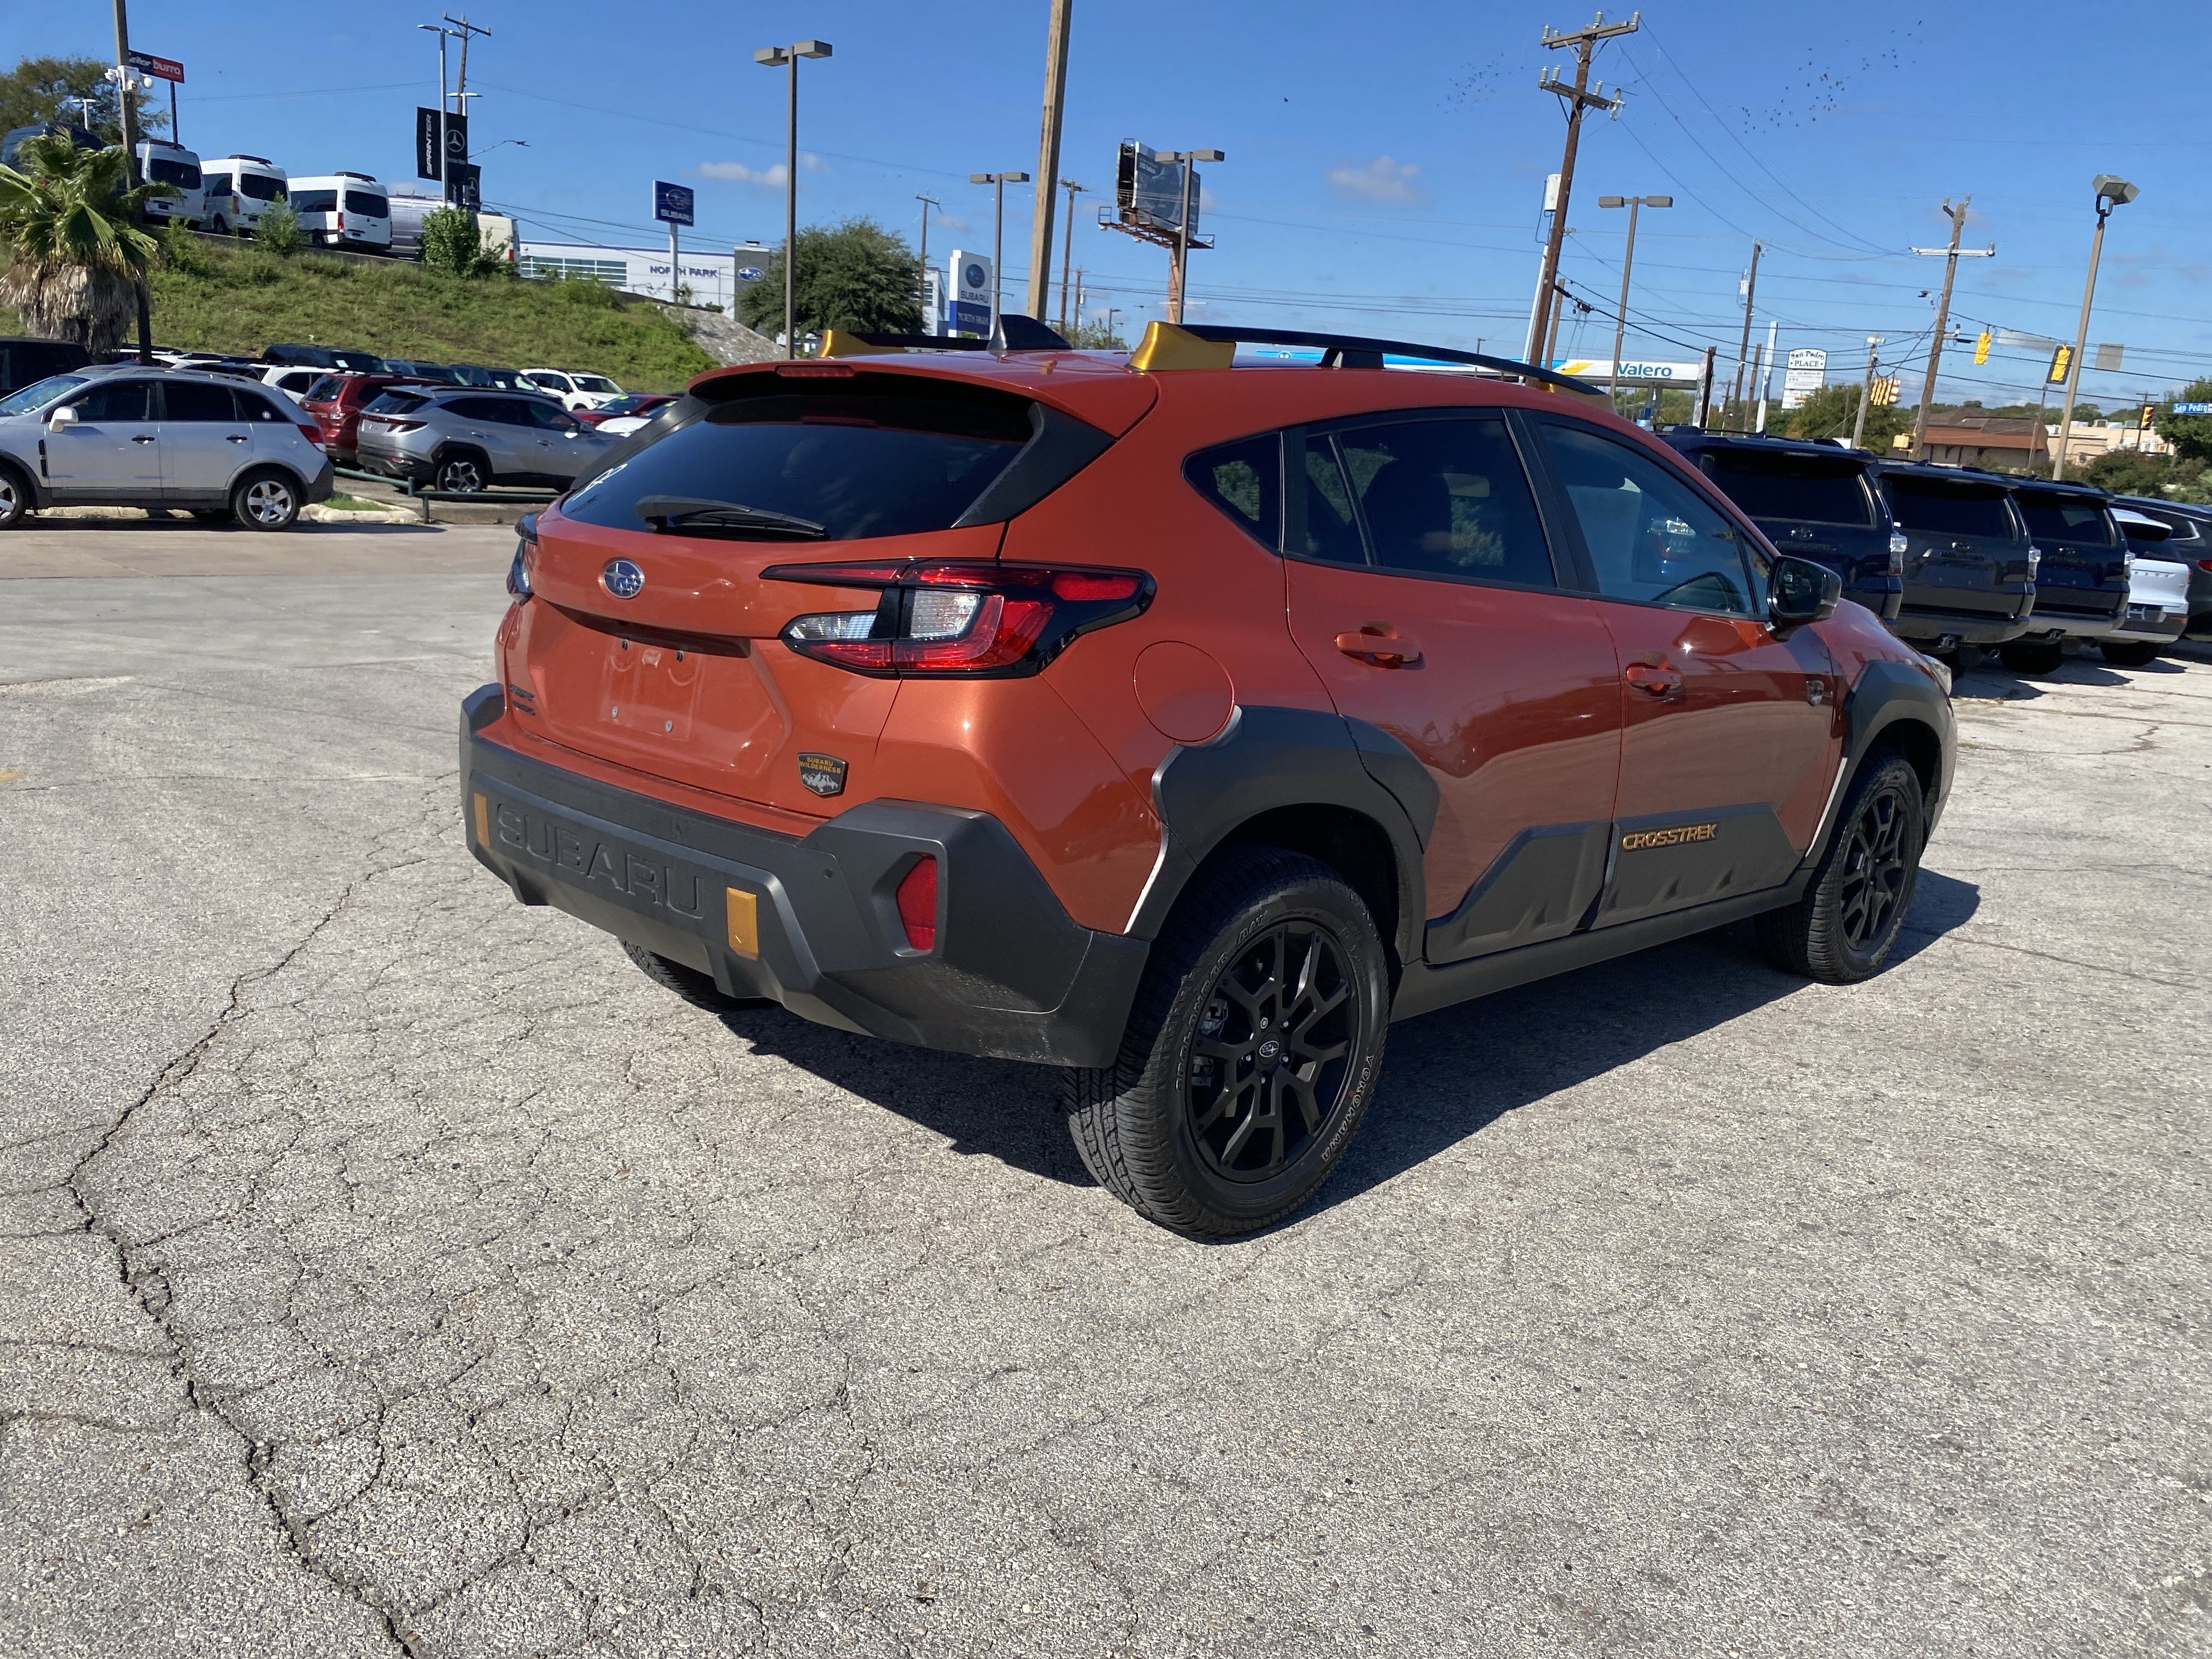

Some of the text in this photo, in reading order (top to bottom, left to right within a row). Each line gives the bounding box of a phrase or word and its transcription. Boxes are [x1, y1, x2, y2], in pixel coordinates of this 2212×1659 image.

[153, 59, 180, 75] burro
[660, 208, 693, 222] SUBARU
[689, 268, 719, 278] PARK
[960, 290, 989, 303] SUBARU
[1805, 351, 1825, 360] Pedro
[1617, 362, 1672, 377] Valero
[2174, 404, 2187, 412] San
[799, 760, 842, 774] WILDERNESS
[806, 757, 833, 766] SUBARU
[1622, 824, 1718, 850] CROSSTREK
[497, 803, 704, 919] SUBARU
[1322, 1054, 1375, 1162] YOKOHAMA
